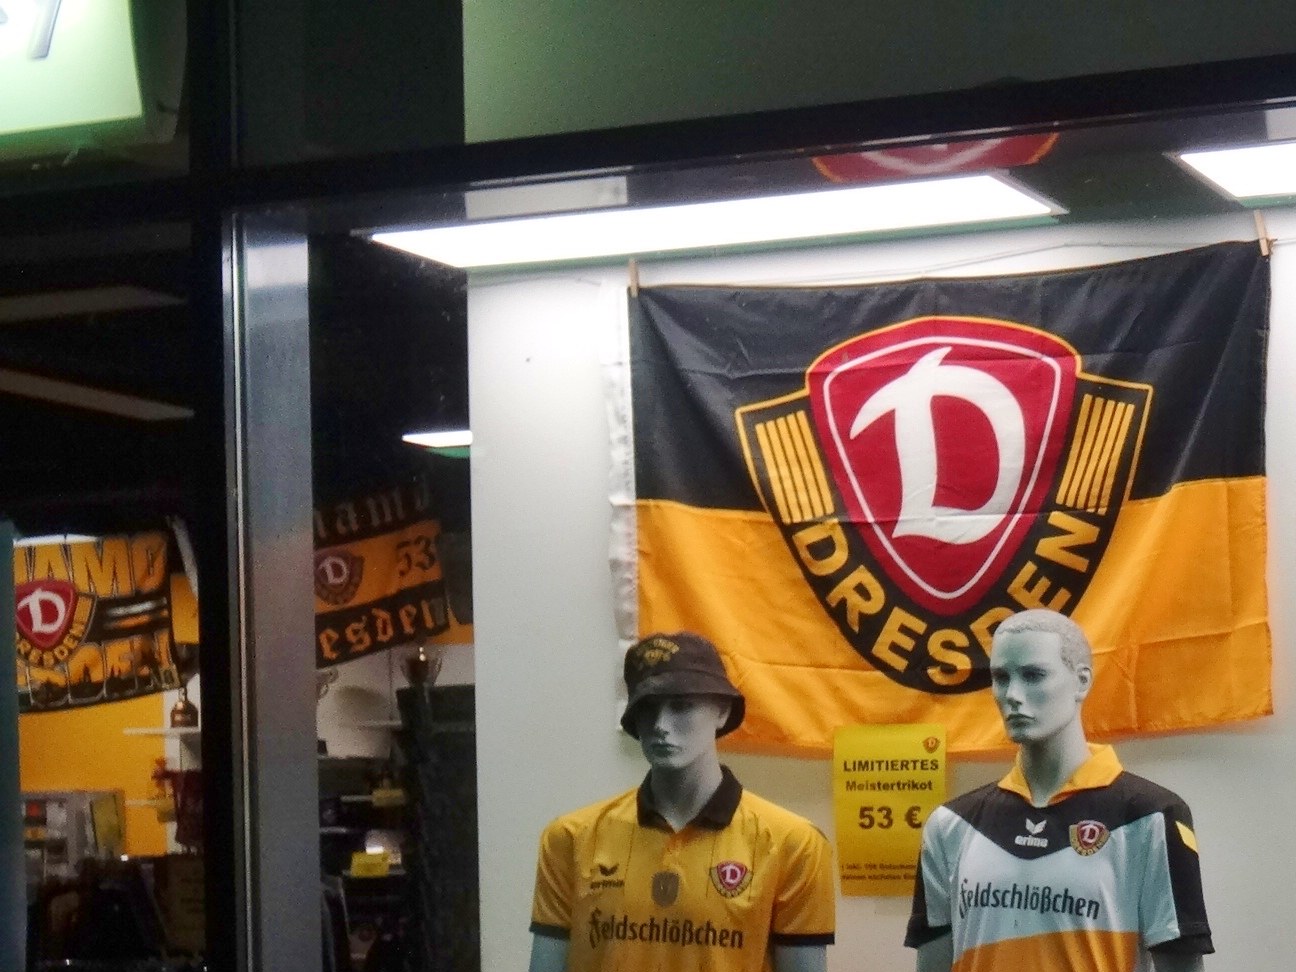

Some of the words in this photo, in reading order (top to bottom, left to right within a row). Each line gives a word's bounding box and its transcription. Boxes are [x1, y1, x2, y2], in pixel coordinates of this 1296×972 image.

[850, 347, 1025, 545] D
[843, 759, 939, 772] LIMITIERTES
[845, 779, 933, 791] Meistertrikot
[858, 805, 894, 830] 53
[904, 805, 922, 830] €
[1014, 834, 1048, 849] erima
